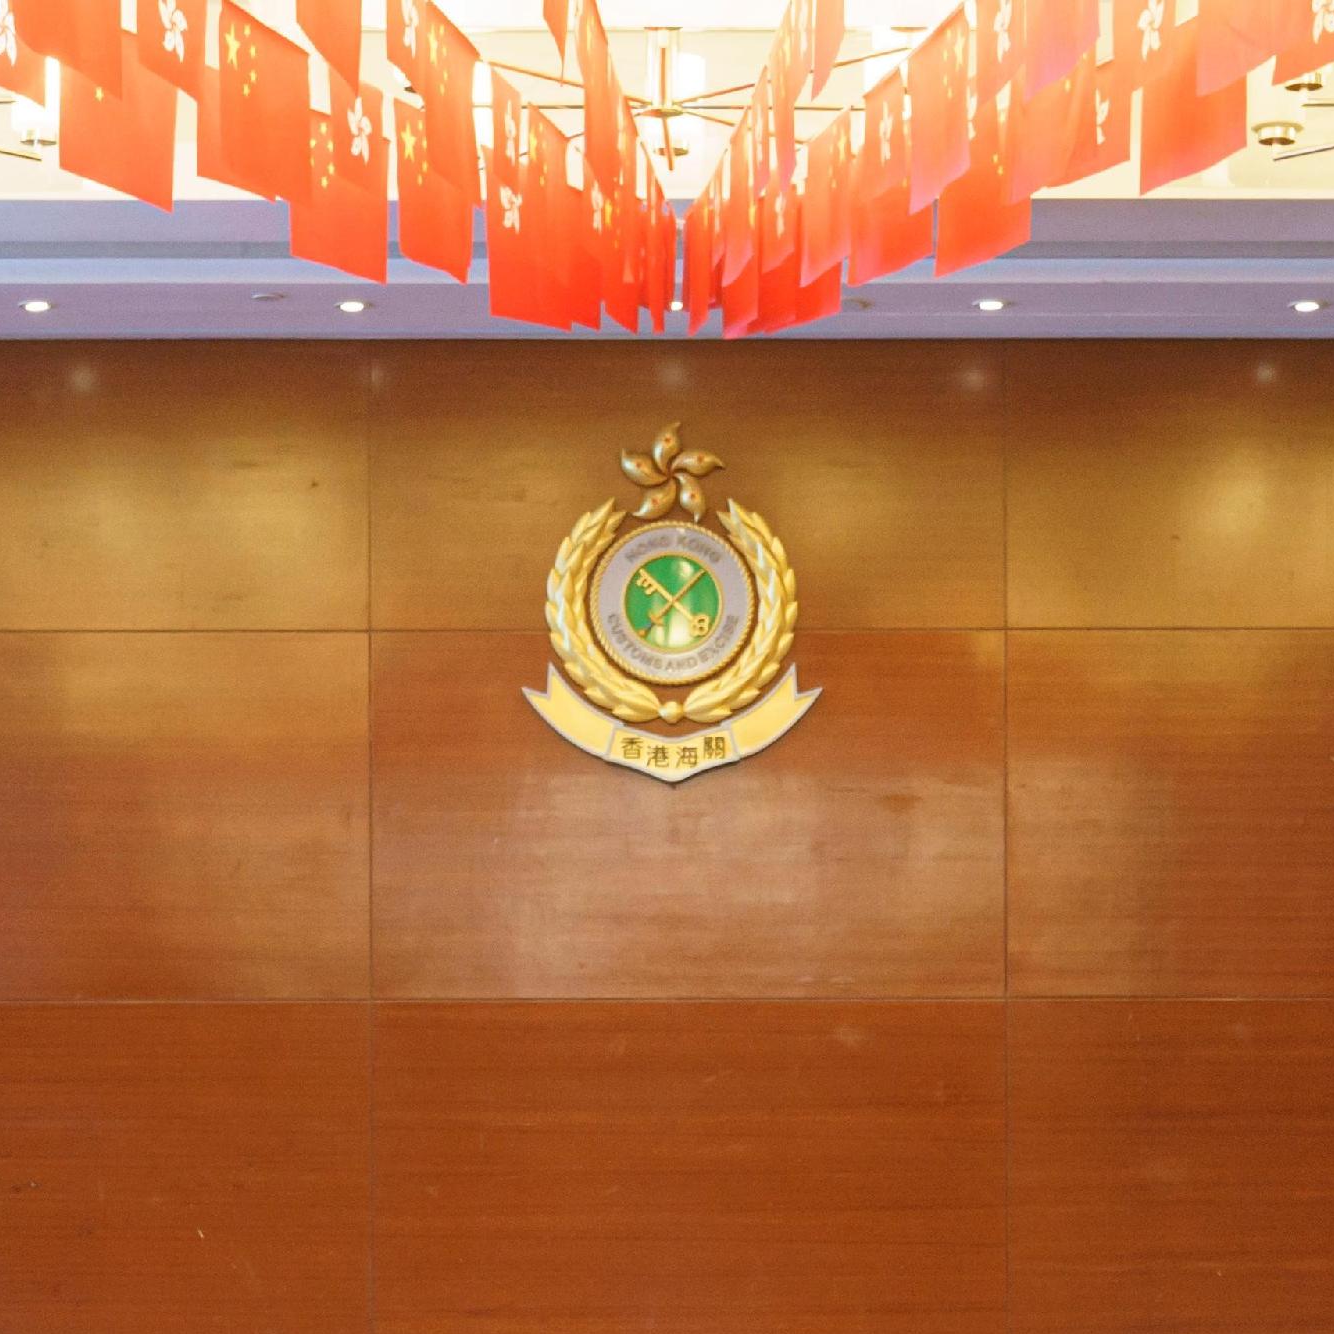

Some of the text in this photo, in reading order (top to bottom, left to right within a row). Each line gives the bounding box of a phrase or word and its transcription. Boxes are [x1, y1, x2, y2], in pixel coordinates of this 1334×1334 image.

[607, 613, 664, 670] CUSTOMS
[664, 658, 699, 673] AND
[620, 735, 727, 768] 香港海關
